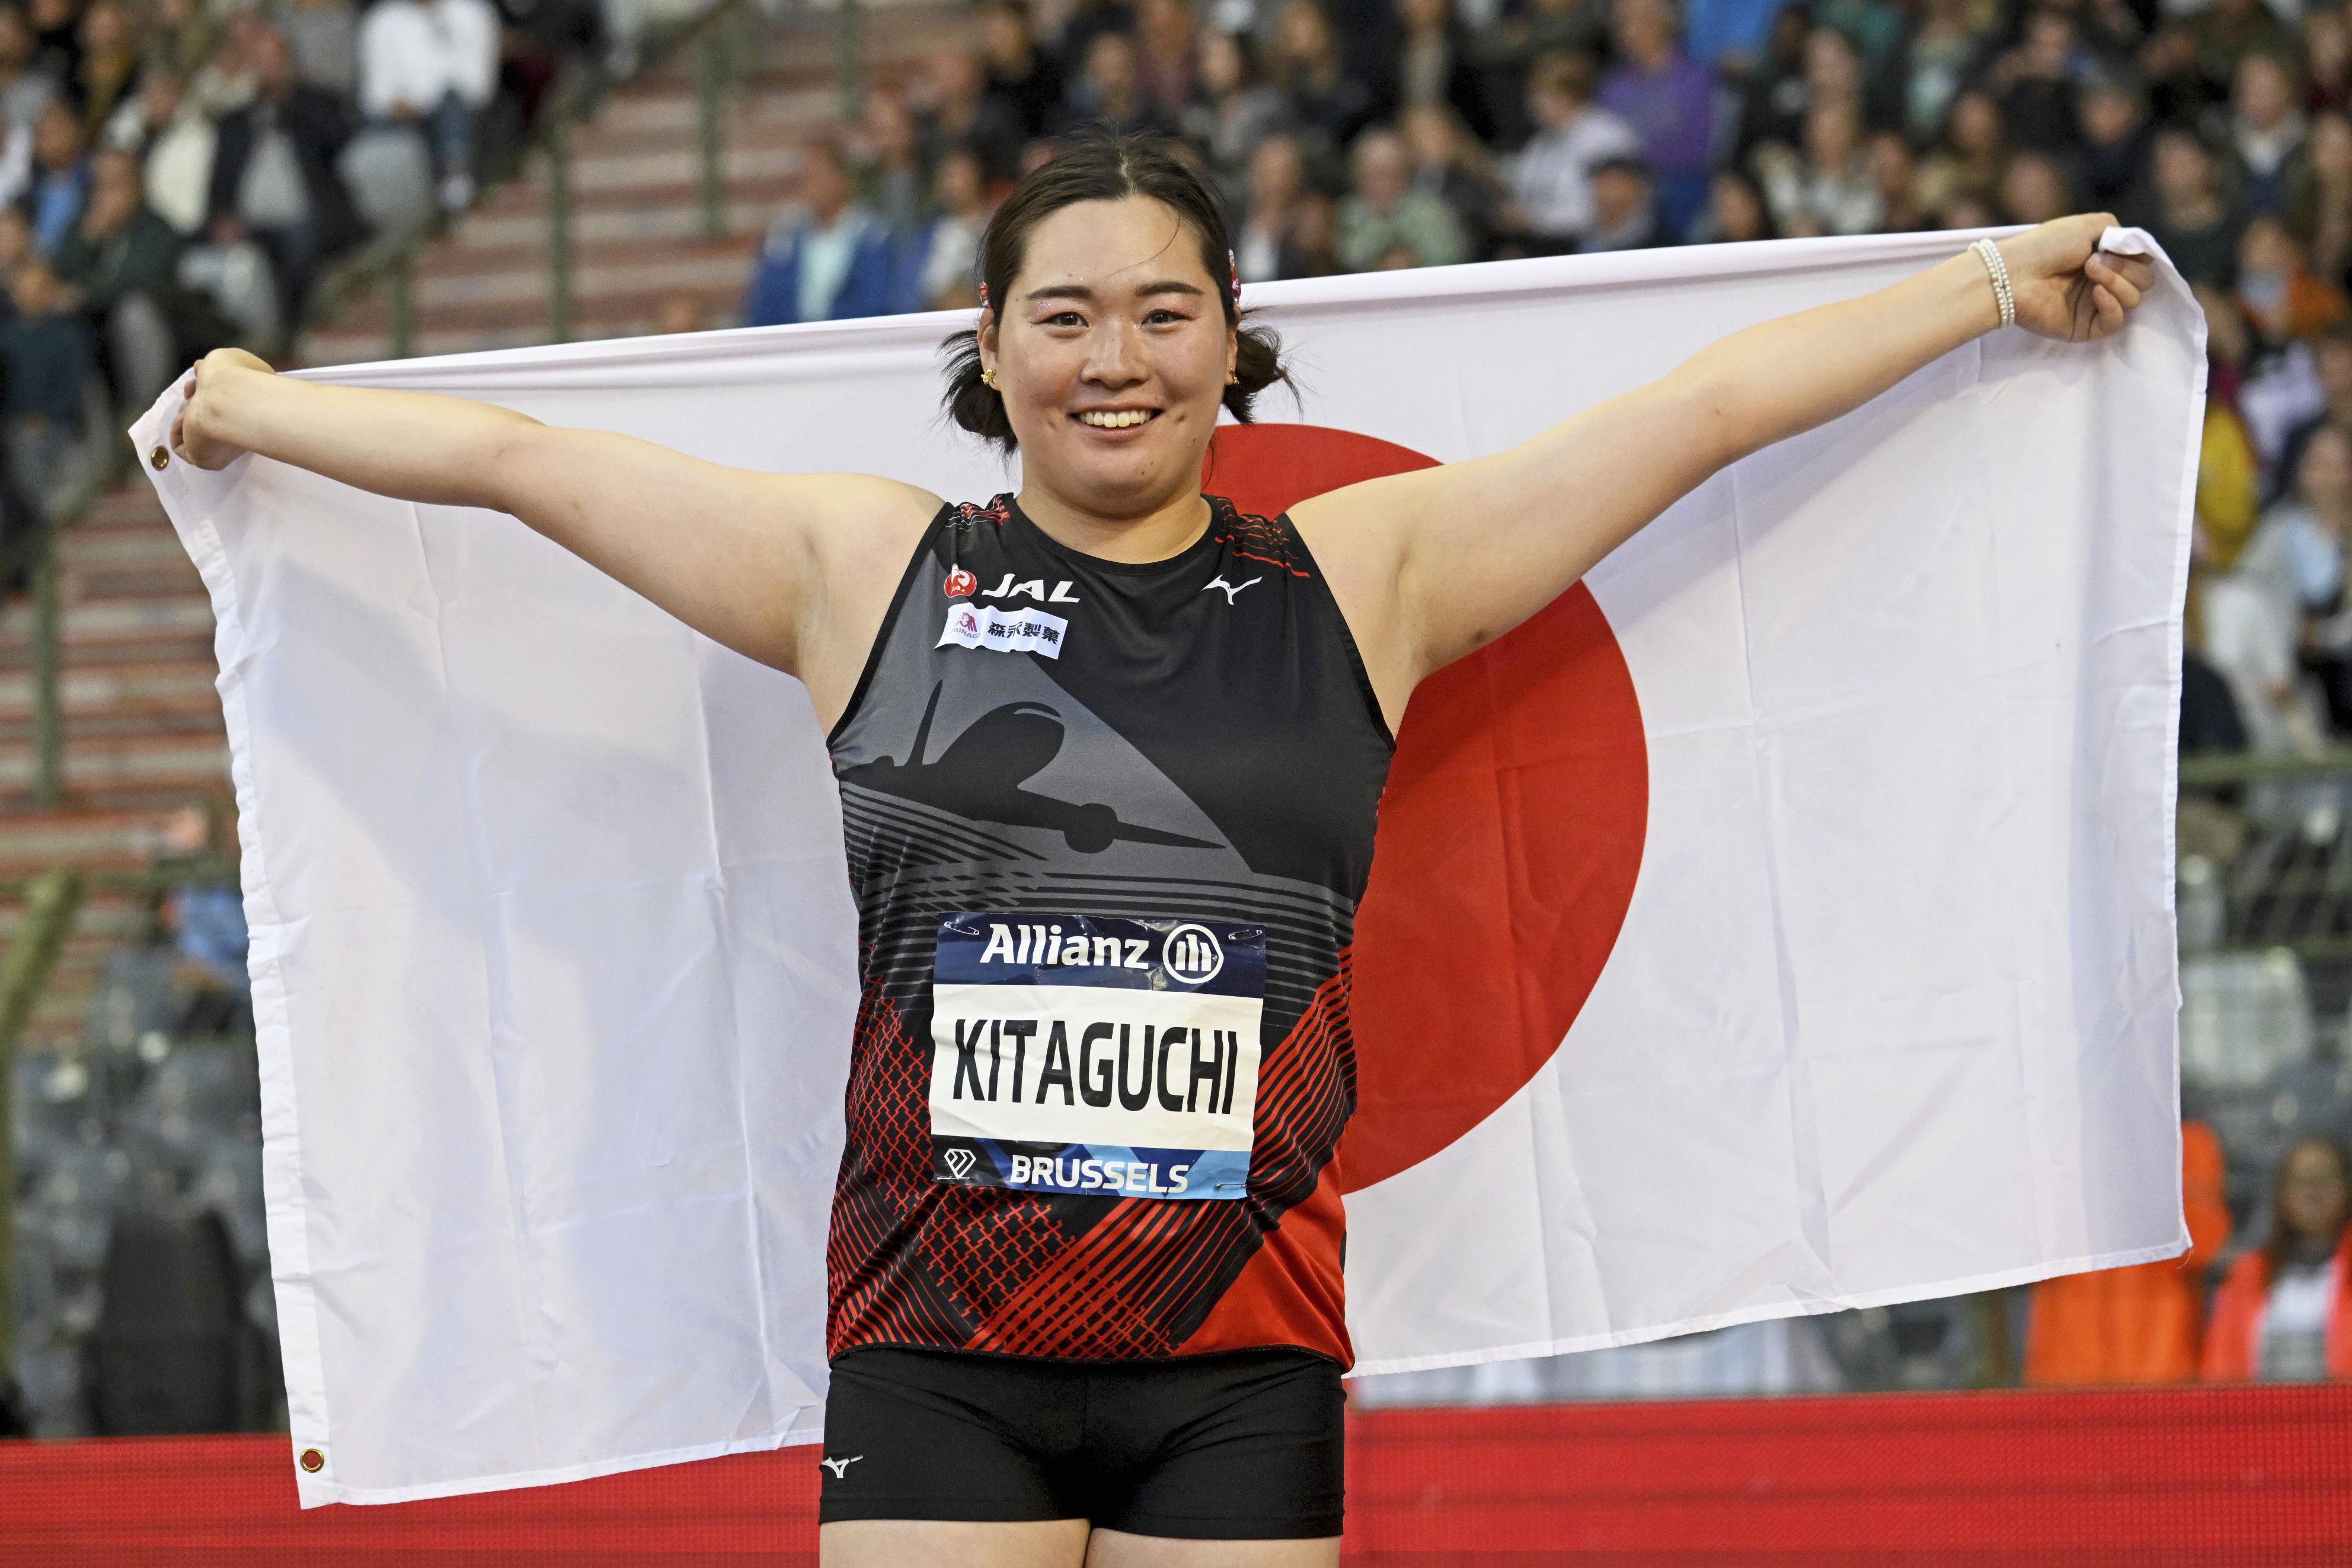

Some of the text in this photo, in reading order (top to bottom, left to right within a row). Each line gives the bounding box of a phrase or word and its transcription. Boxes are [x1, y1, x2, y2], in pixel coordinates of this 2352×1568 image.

[982, 573, 1080, 603] JAL
[988, 621, 1060, 645] 森永製菓
[980, 923, 1149, 969] Allianz
[953, 1018, 1238, 1115] KITAGUCHI
[1009, 1154, 1190, 1193] BRUSSELS
